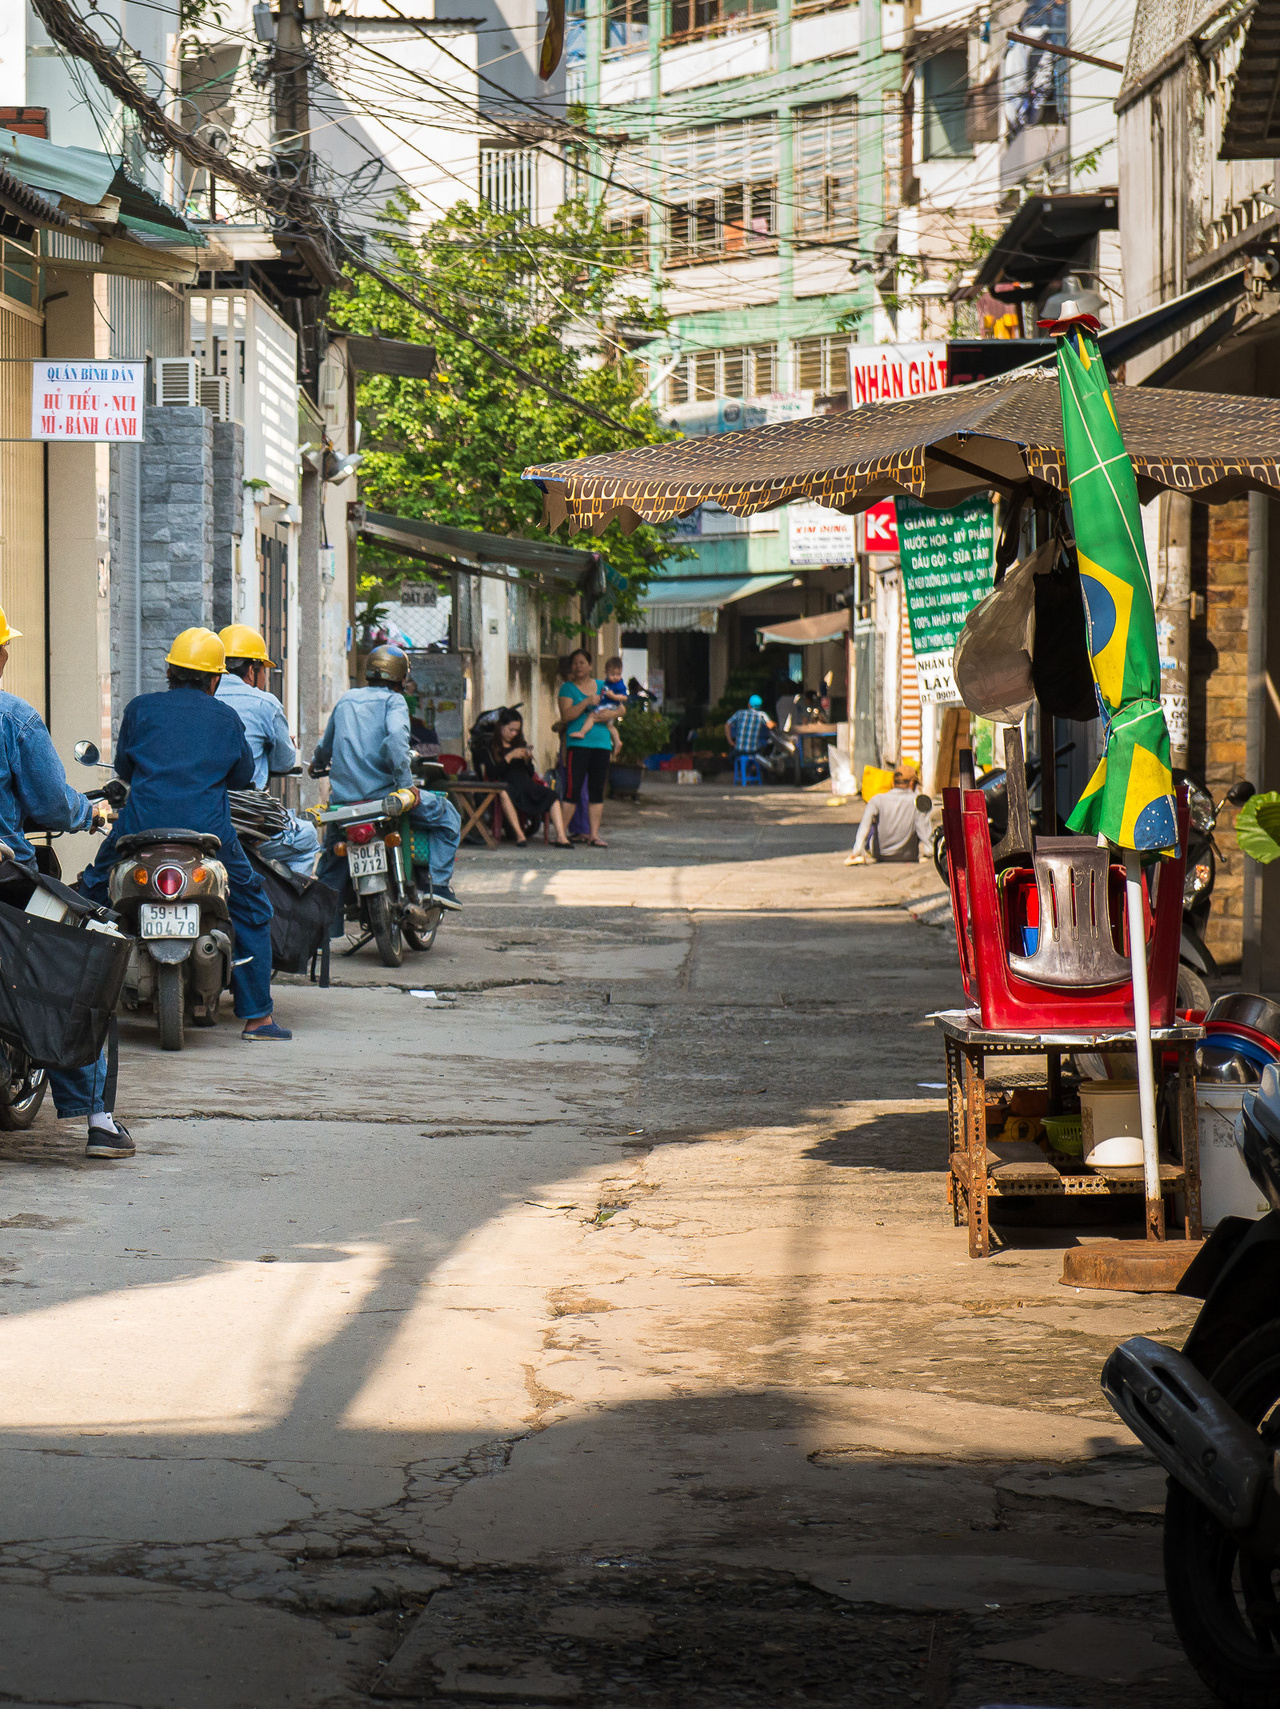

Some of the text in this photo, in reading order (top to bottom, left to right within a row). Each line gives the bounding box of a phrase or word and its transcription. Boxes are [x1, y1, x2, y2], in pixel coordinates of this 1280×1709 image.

[47, 364, 135, 382] QUÁN BÌNH DÂN
[43, 387, 63, 410] HỦ
[67, 387, 100, 411] TIẾU
[112, 395, 136, 412] NUI
[40, 410, 56, 434] MÌ
[65, 411, 99, 435] BÁNH
[105, 417, 137, 436] CANH
[903, 511, 937, 531] GIẢM
[939, 513, 954, 526] 30
[903, 533, 928, 551] NƯỚC
[929, 533, 948, 547] HOA
[953, 527, 966, 544] MỸ
[150, 906, 188, 920] 59-L1
